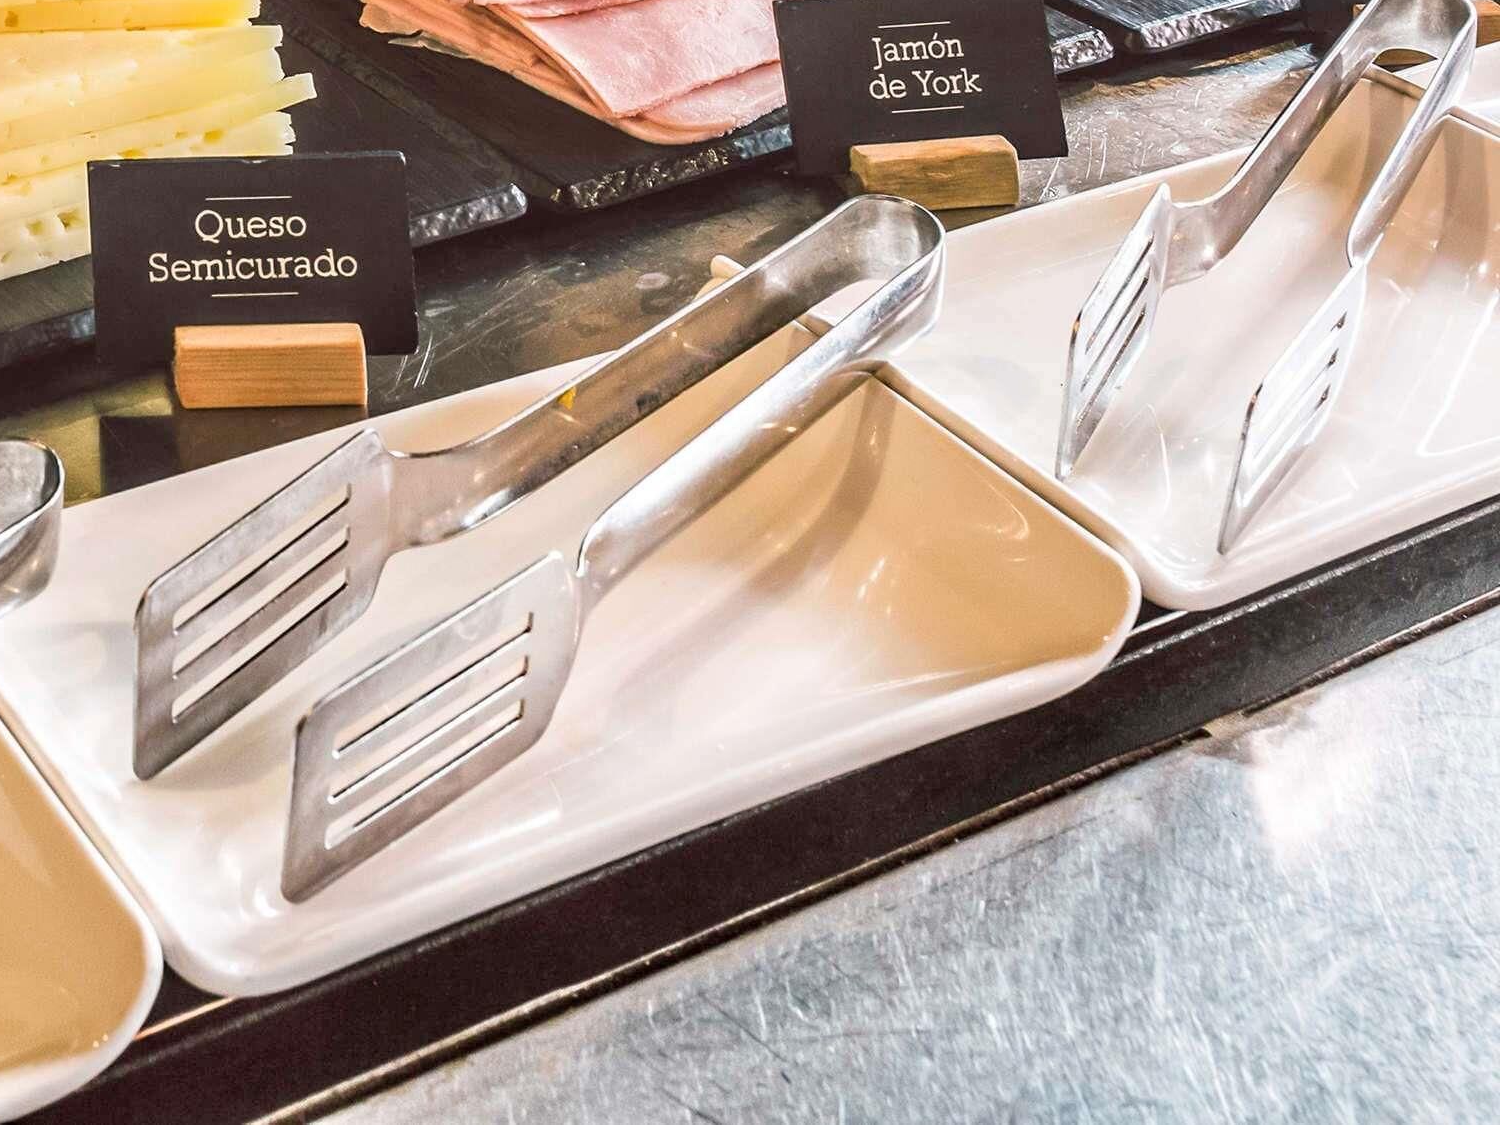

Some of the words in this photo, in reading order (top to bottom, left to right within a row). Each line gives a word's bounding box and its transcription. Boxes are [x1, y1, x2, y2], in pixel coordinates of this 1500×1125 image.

[872, 32, 964, 70] Jamón
[869, 74, 907, 100] de
[912, 68, 982, 96] York
[194, 210, 307, 243] Queso
[149, 248, 358, 283] Semicurado
